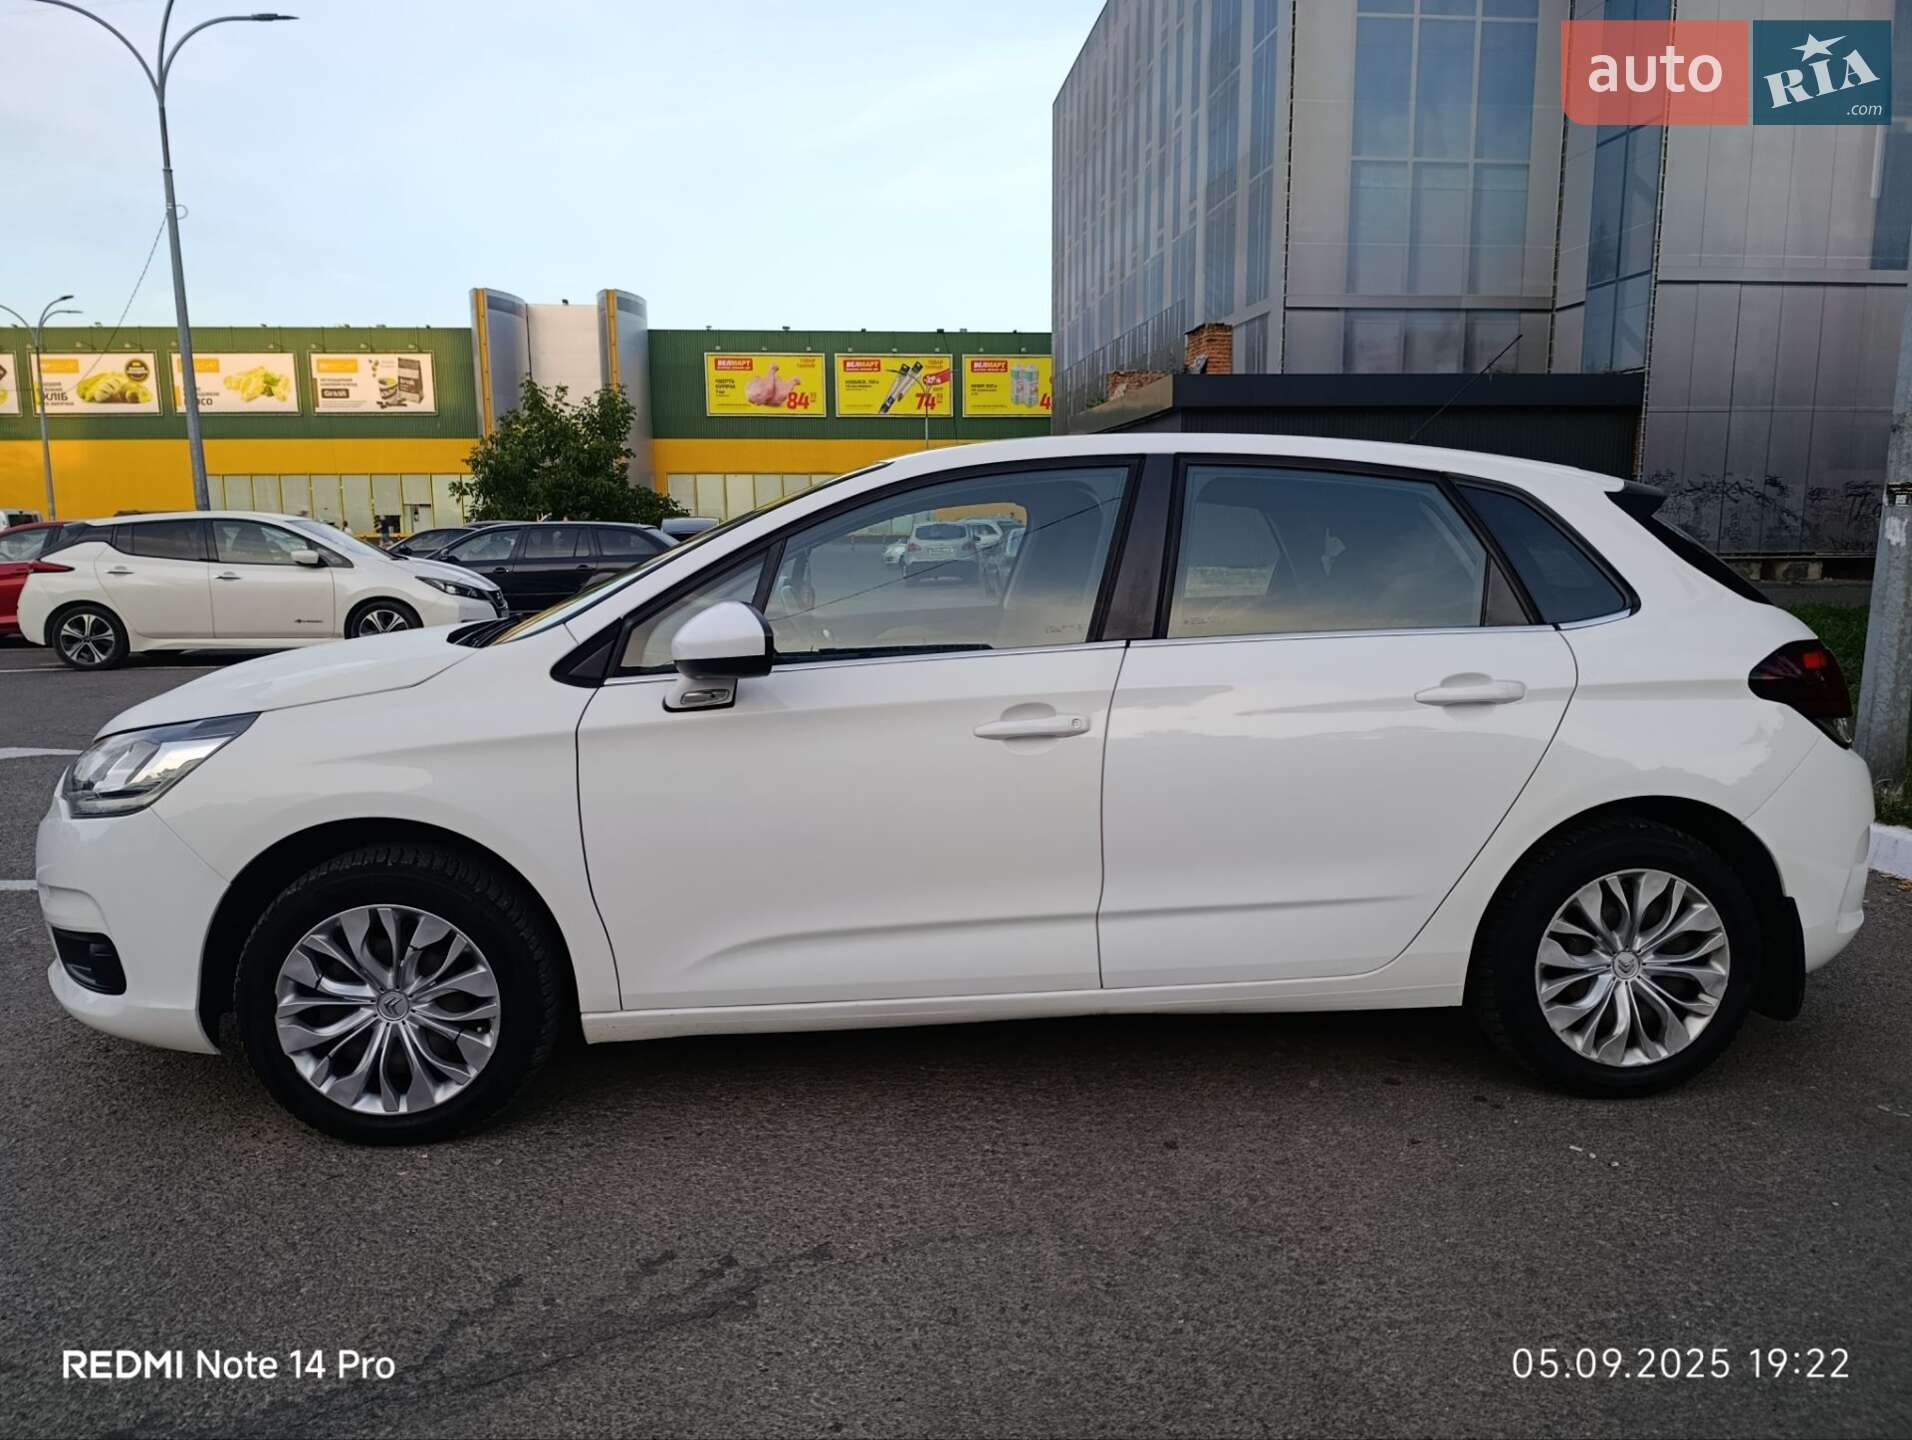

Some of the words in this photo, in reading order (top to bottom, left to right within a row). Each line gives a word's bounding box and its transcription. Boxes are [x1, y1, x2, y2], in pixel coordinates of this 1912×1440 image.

[787, 392, 810, 409] 84
[915, 392, 936, 410] 74
[1040, 392, 1052, 410] 4
